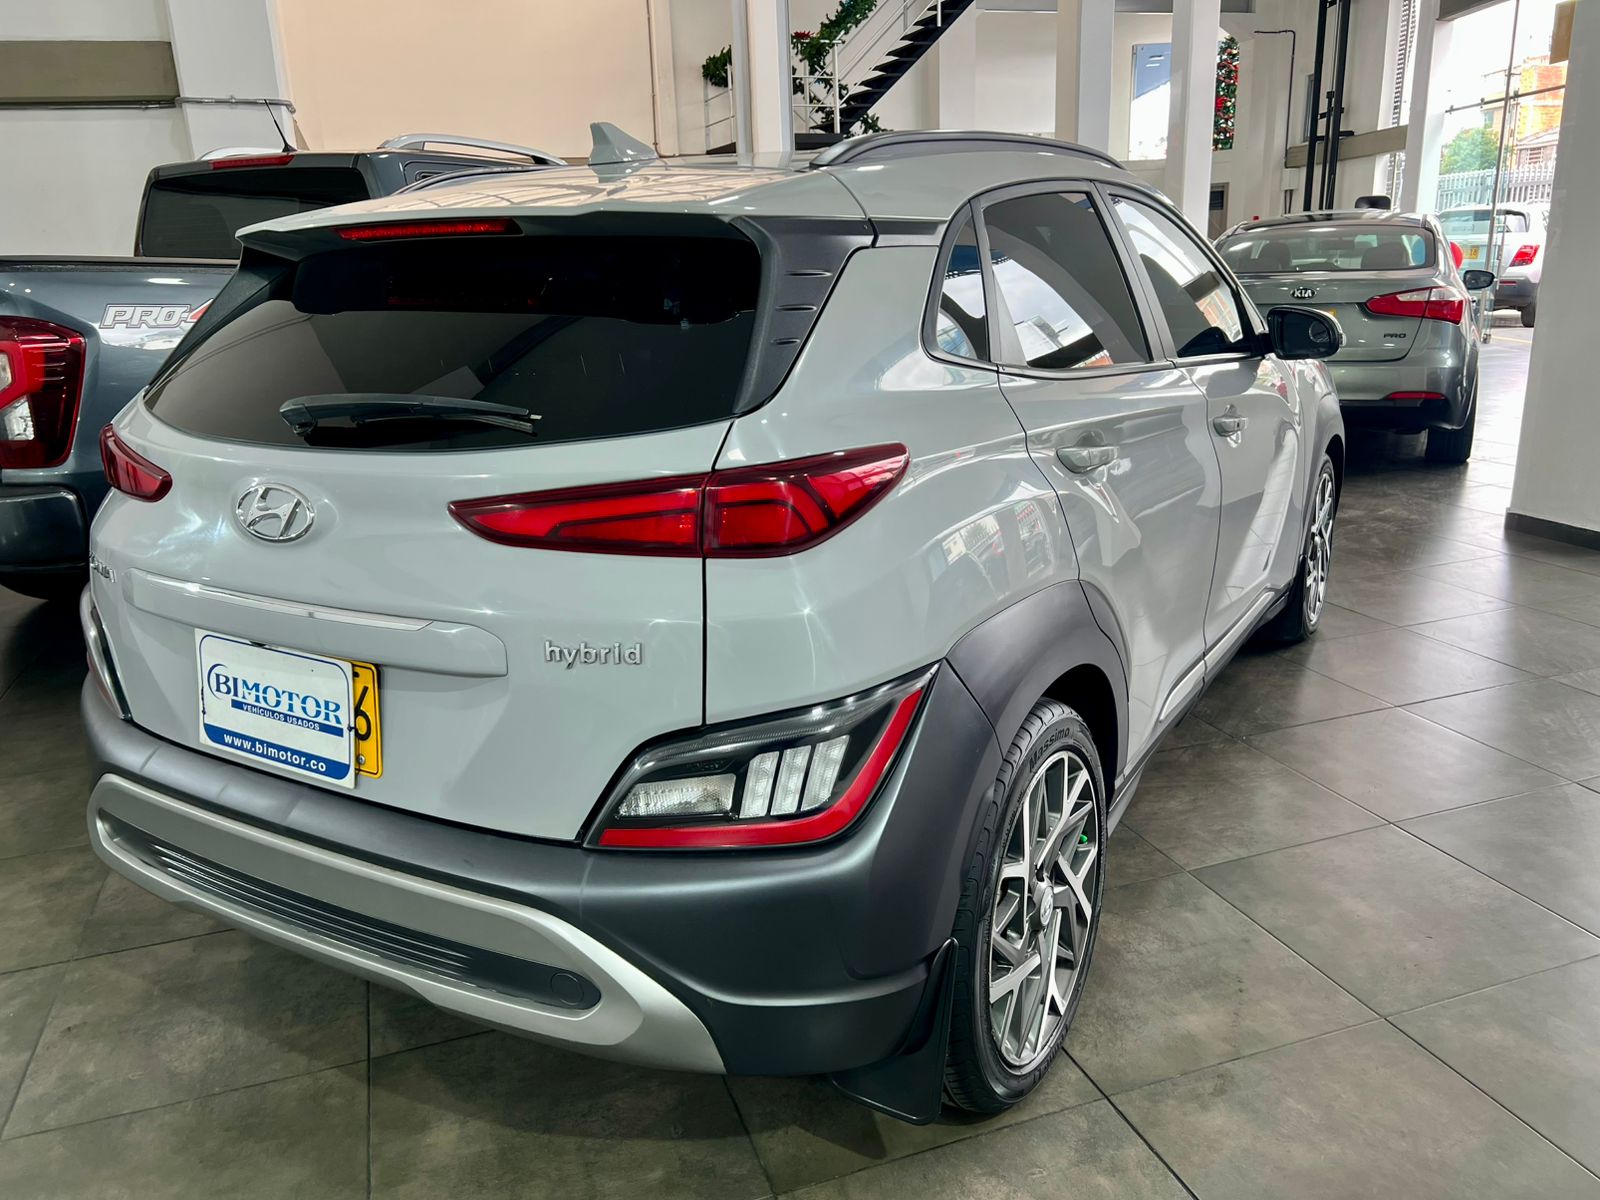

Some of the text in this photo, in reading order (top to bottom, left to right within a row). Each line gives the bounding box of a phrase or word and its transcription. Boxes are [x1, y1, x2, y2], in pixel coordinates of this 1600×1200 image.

[544, 639, 643, 670] hybrid
[213, 671, 343, 725] BIMOTOR
[242, 703, 320, 731] VEHÍCULOS USADOS
[223, 733, 327, 772] www.bimotor.co
[1029, 727, 1070, 773] Massimo
